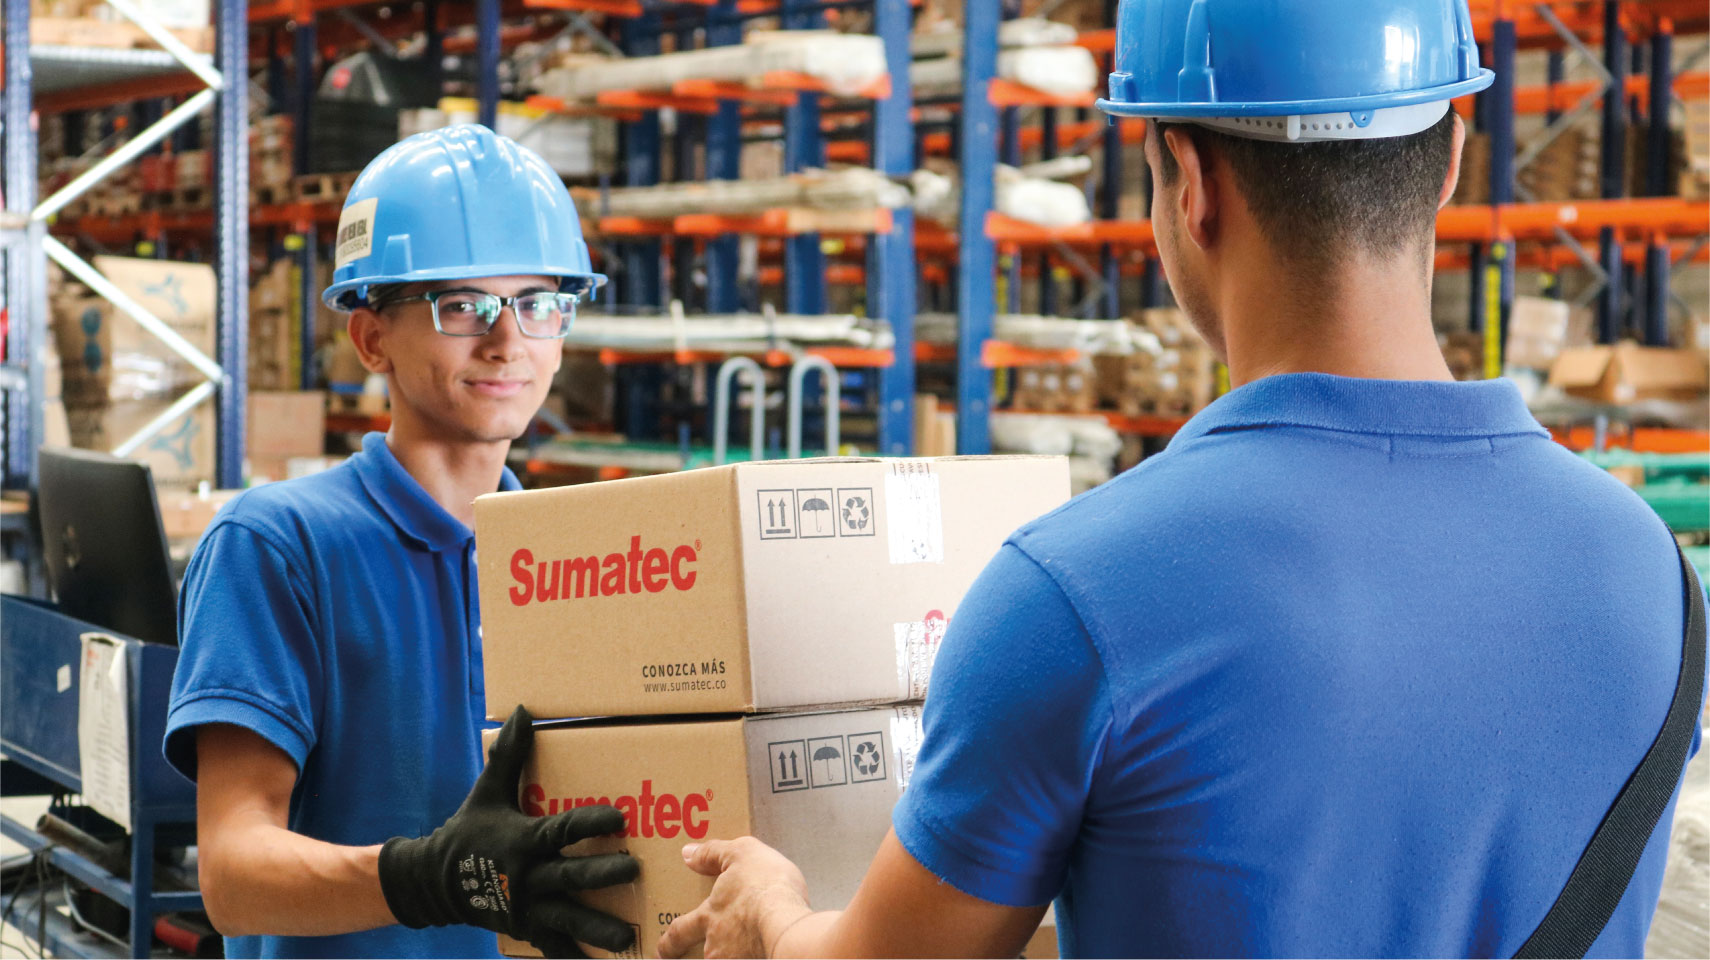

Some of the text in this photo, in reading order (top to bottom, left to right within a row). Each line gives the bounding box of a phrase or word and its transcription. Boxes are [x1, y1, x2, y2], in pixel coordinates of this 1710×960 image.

[642, 658, 726, 678] CONOZCA MÁS
[643, 679, 727, 693] www.sumatec.co
